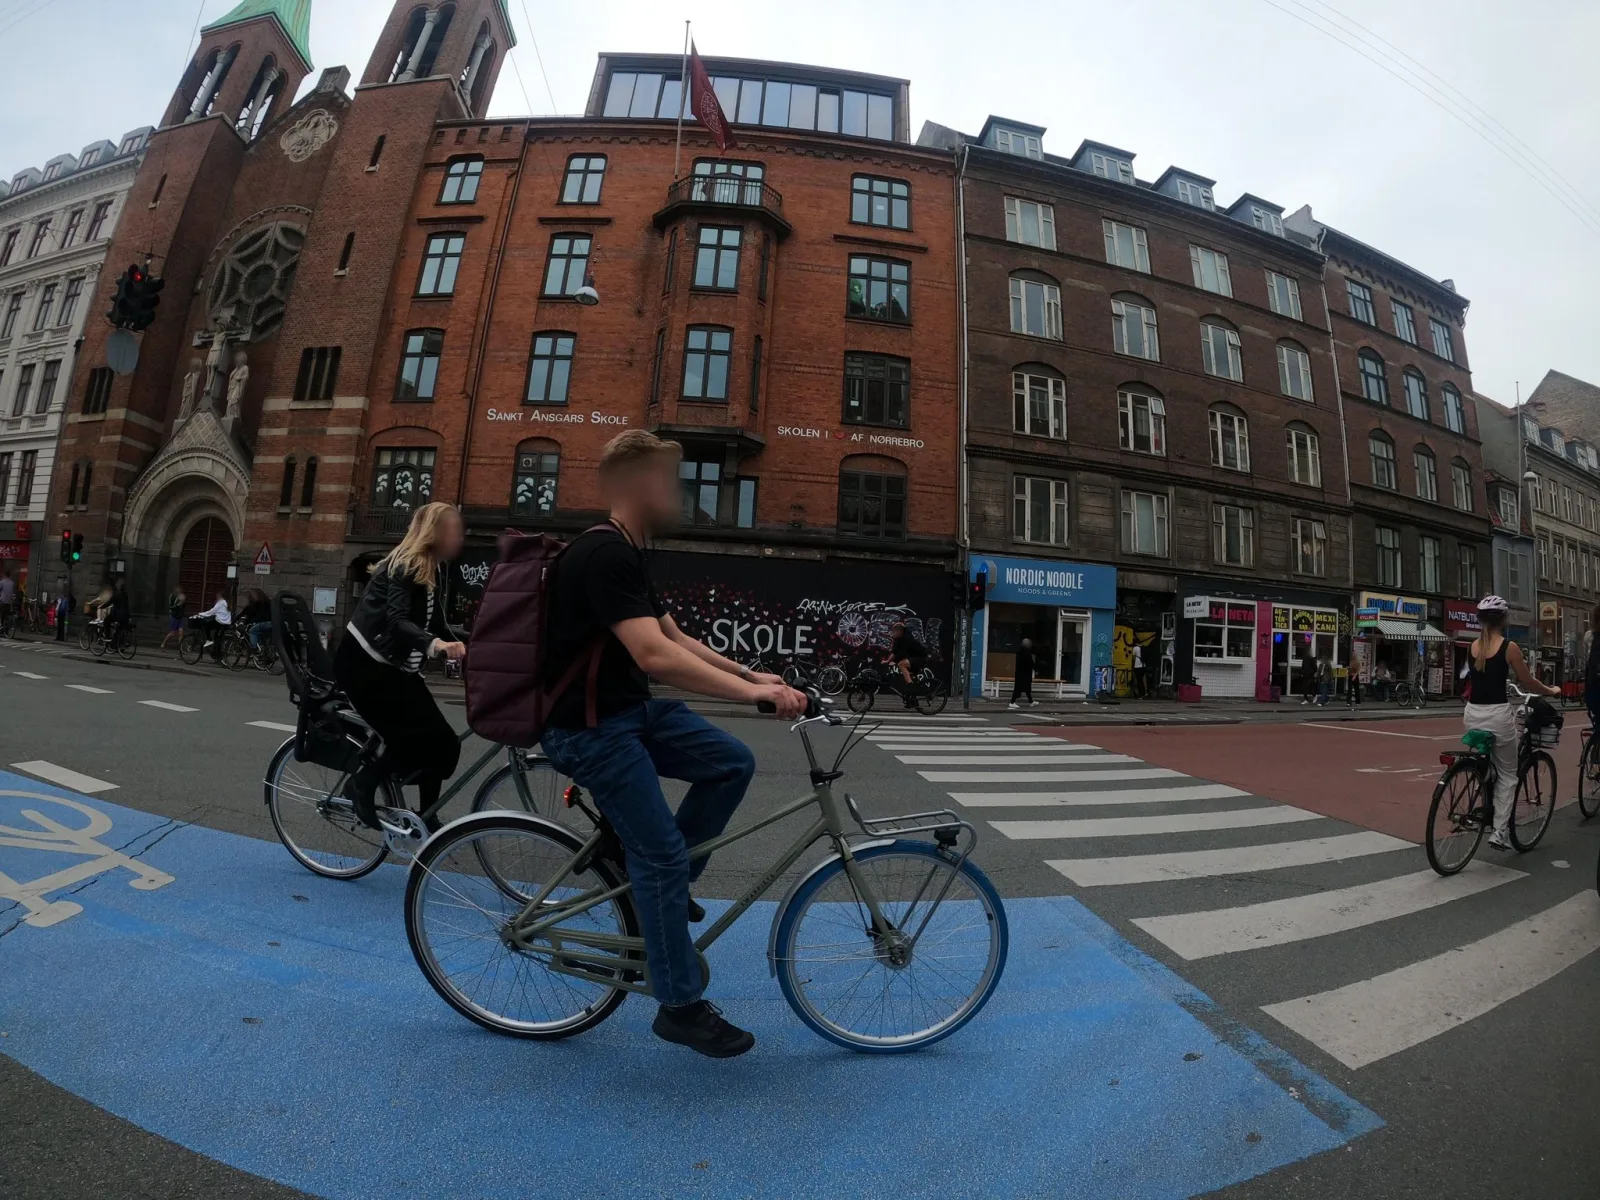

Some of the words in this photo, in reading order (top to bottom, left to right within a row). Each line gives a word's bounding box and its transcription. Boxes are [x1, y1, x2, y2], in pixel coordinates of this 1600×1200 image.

[777, 426, 820, 438] SKOLEN
[825, 430, 829, 439] I
[850, 433, 864, 442] AF
[869, 435, 925, 449] NØRREBRO
[1005, 567, 1045, 587] NORDIC
[1046, 570, 1084, 590] NOODLE
[1017, 587, 1041, 595] NOODS
[1211, 607, 1225, 620] LA
[1229, 608, 1254, 621] NETA
[1316, 614, 1336, 623] MEXI
[1316, 623, 1336, 632] CANA
[708, 618, 814, 655] SKOLE
